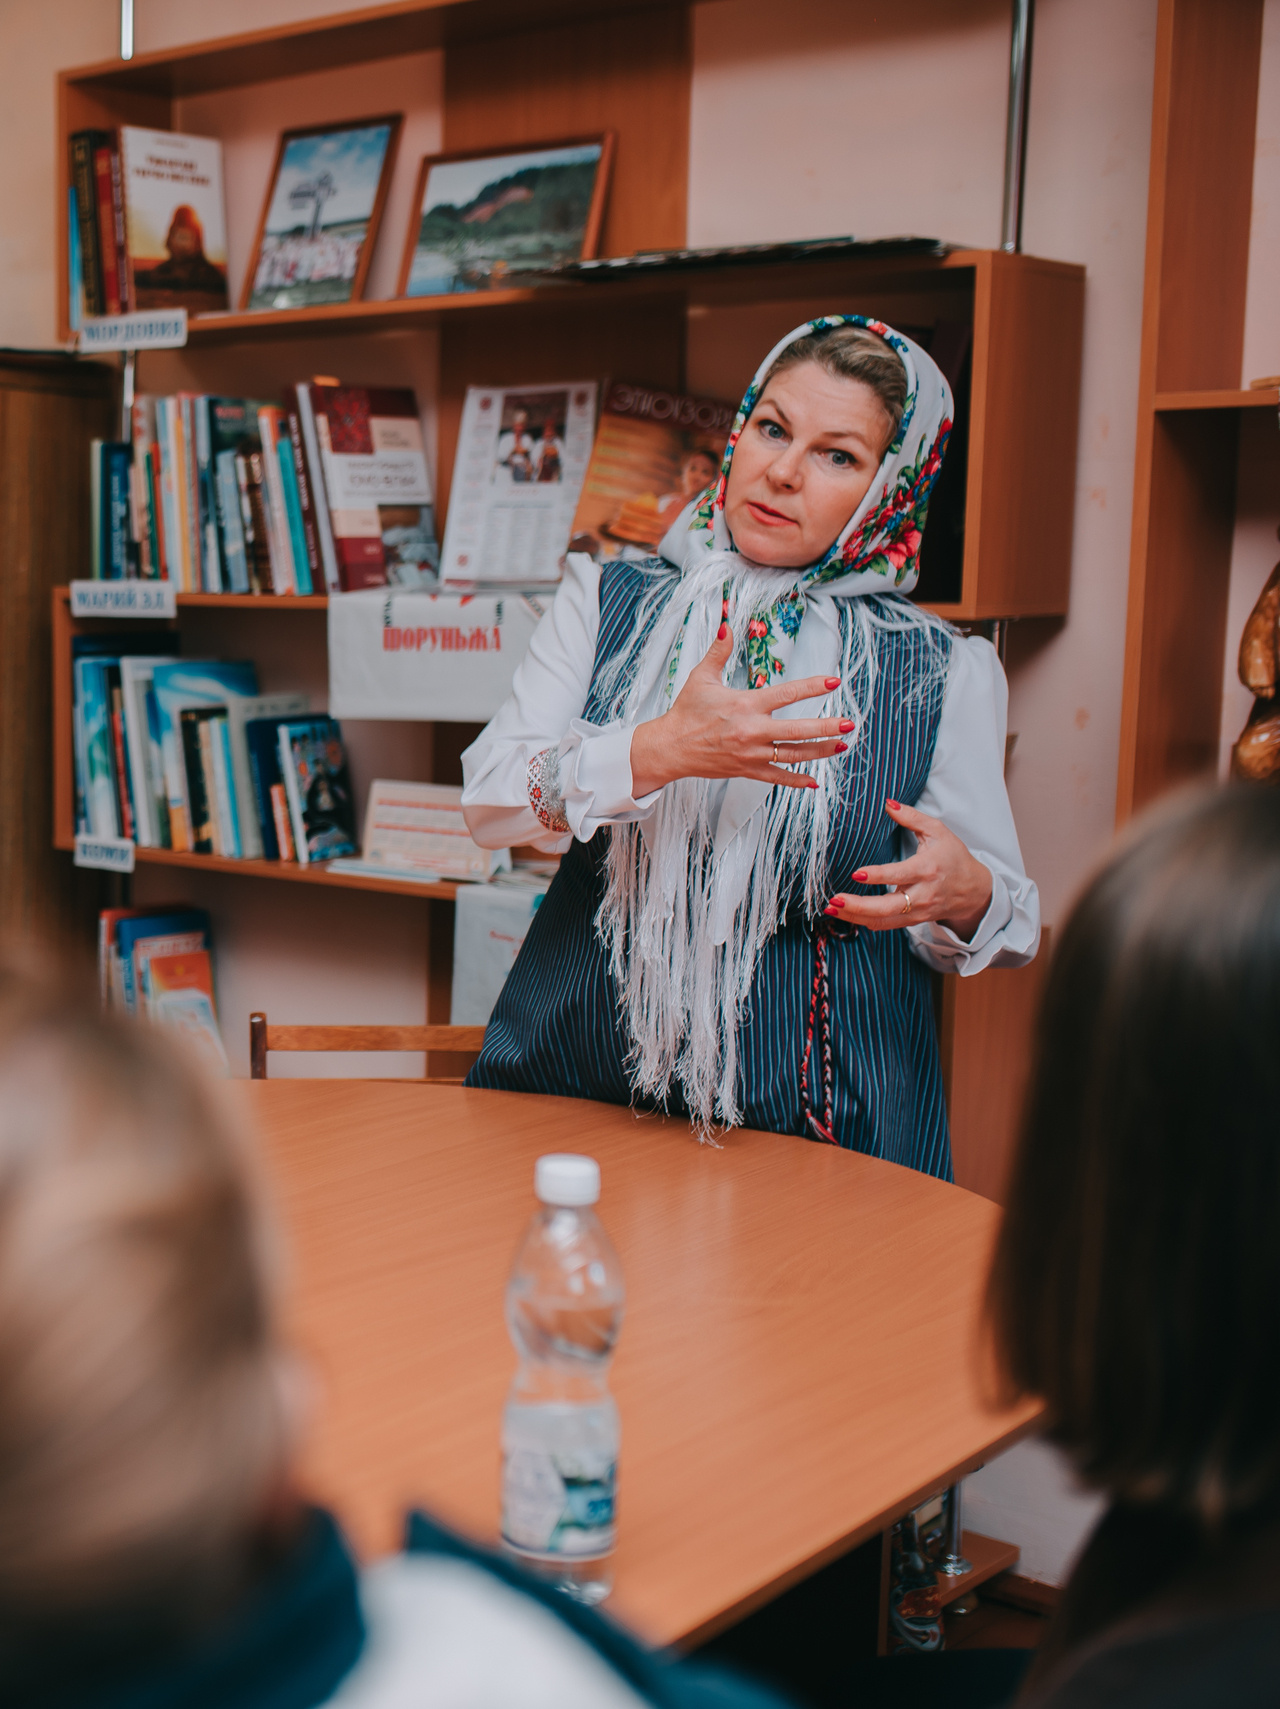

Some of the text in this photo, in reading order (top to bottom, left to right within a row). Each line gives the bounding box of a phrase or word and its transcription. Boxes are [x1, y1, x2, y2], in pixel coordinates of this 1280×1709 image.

[83, 321, 183, 341] МОРДОВИЯ
[76, 588, 166, 609] МАРИЙ ЭЛ
[383, 626, 502, 652] ШОРУНЬЖА
[79, 843, 130, 866] КОМИ
